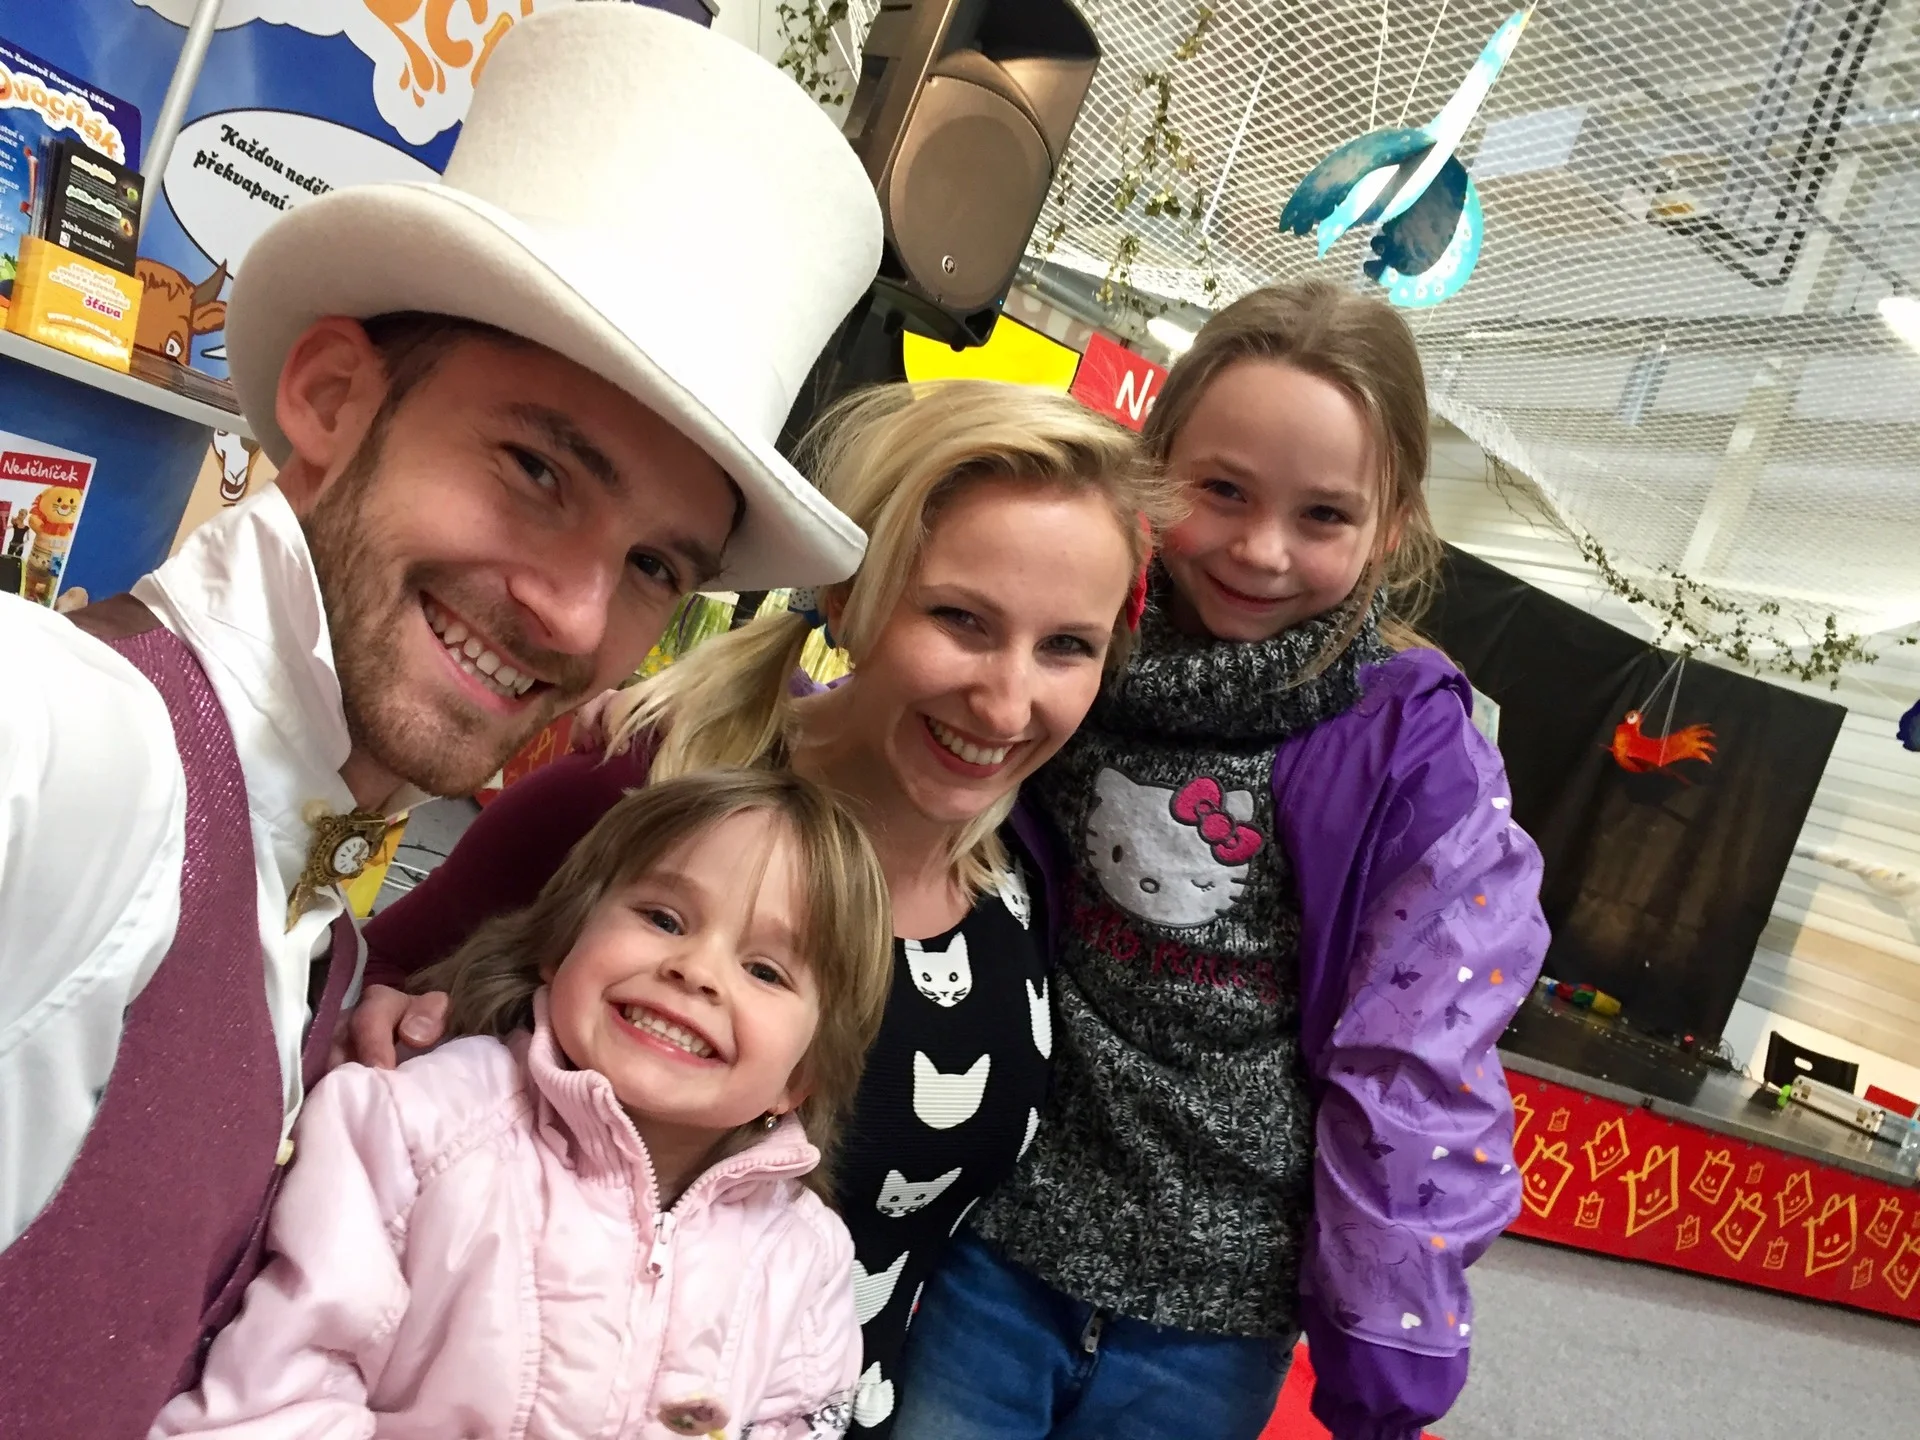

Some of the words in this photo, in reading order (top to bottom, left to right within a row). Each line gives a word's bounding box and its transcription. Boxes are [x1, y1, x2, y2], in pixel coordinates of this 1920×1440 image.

[193, 149, 290, 211] překvapení
[220, 123, 284, 174] Každou
[285, 167, 334, 196] neděl
[85, 295, 121, 318] šťáva
[2, 457, 79, 483] Nedělníček
